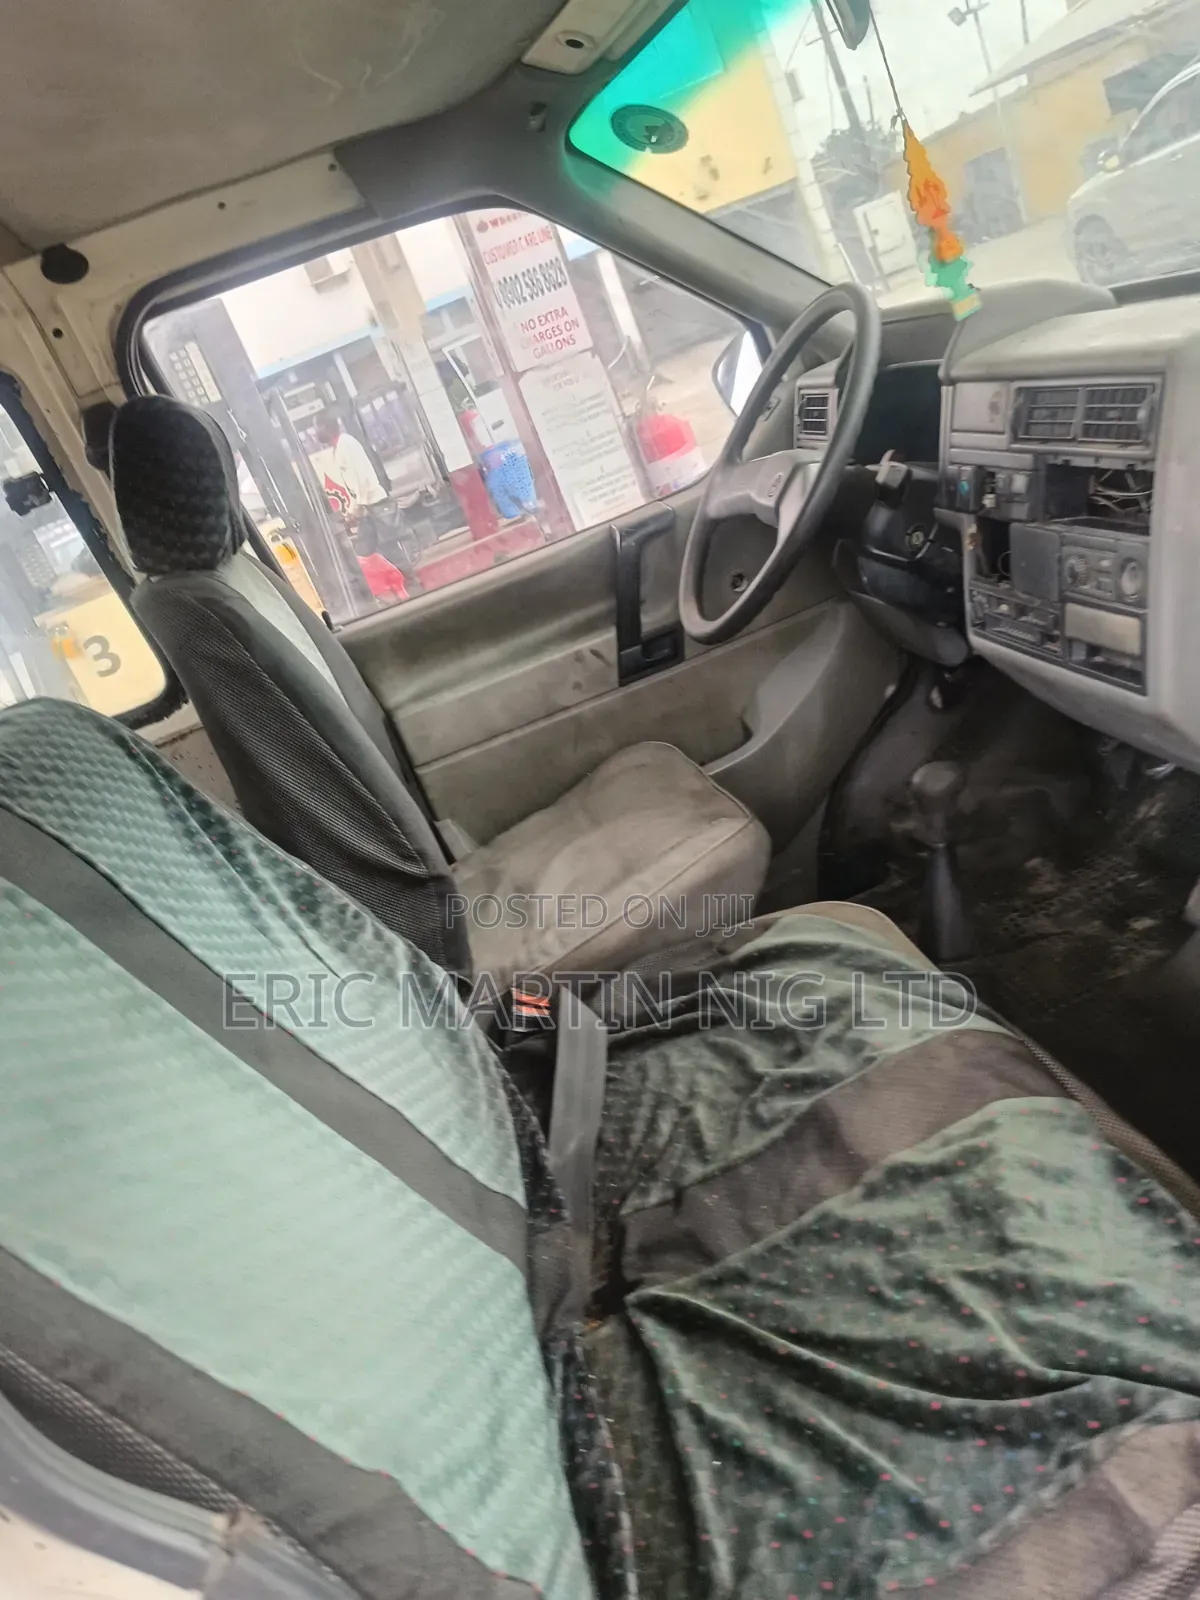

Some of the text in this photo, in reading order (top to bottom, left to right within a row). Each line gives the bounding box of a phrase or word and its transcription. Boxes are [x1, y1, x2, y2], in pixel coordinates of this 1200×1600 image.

[483, 238, 519, 266] CUSTOMER
[518, 231, 539, 250] CARE
[520, 306, 569, 334] NO EXTRA
[521, 317, 580, 350] CARGES ON
[532, 334, 576, 359] GALLONS
[83, 635, 121, 677] 3
